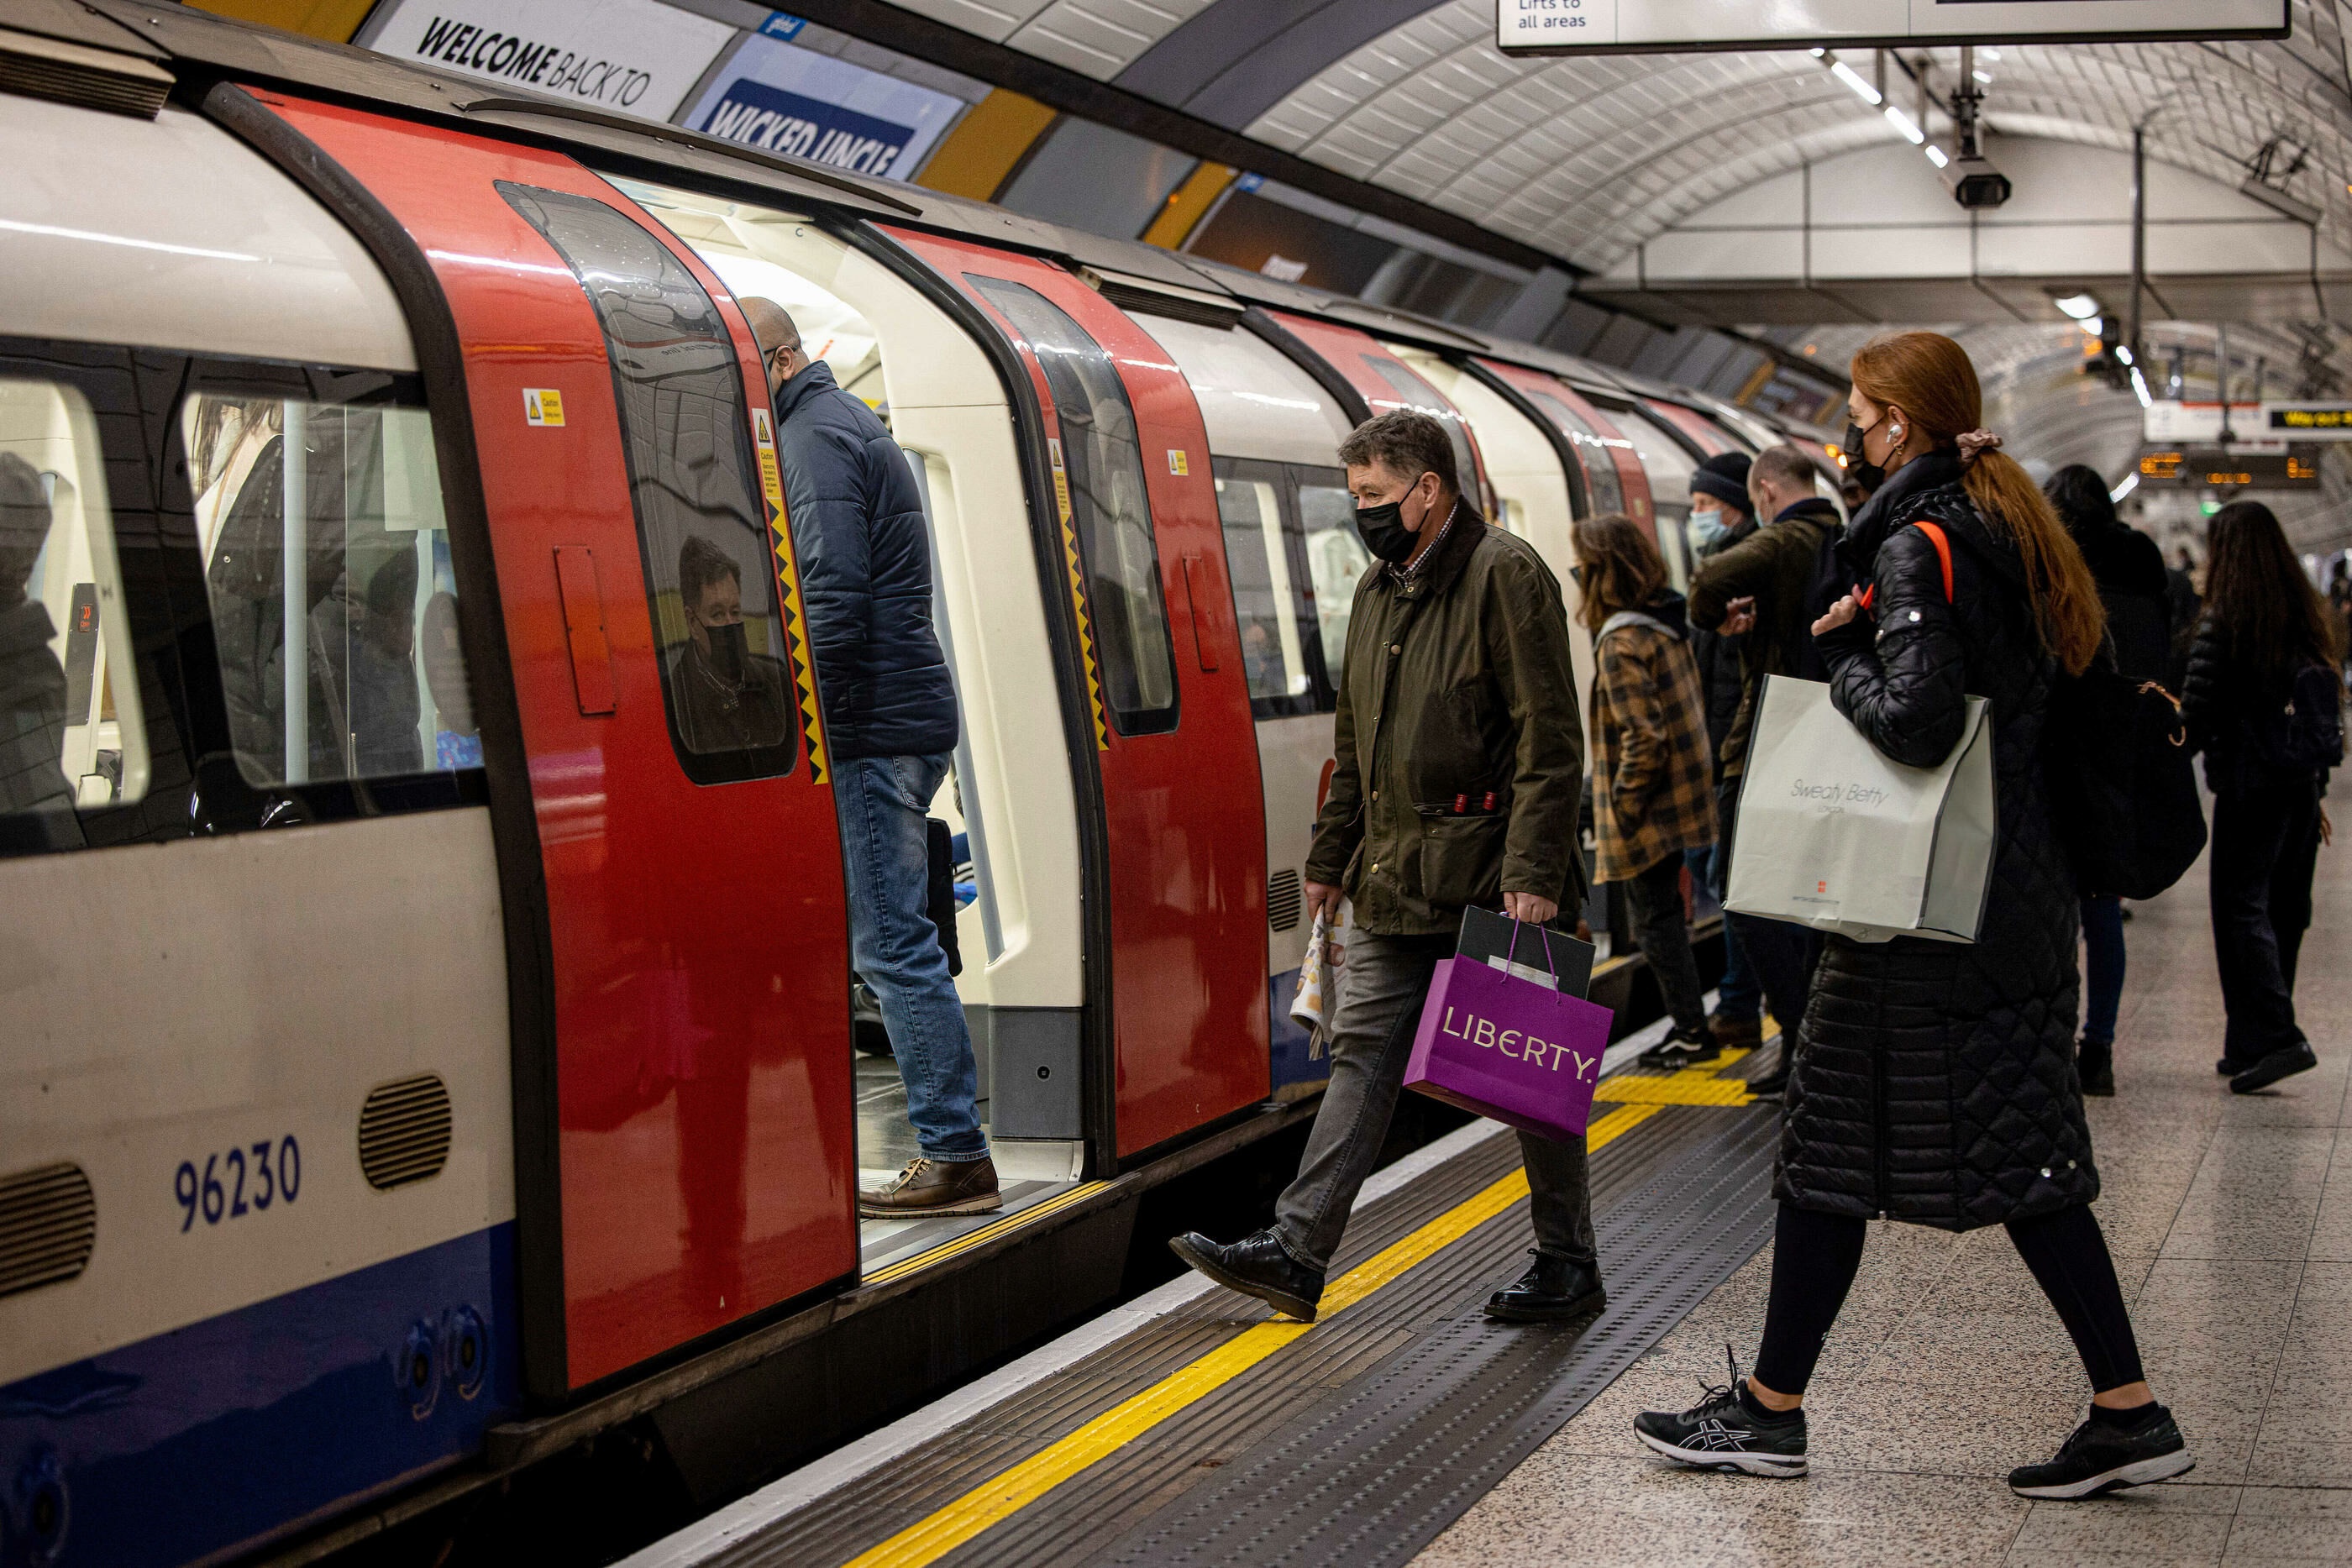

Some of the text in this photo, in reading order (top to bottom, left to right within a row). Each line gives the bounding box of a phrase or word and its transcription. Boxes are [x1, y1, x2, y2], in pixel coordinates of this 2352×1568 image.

[1519, 15, 1586, 29] all areas
[1520, 0, 1581, 9] Lifts to
[417, 16, 651, 107] WELCOME BACK TO
[707, 99, 818, 159] WICKED
[1791, 779, 1890, 808] Sweaty Betty
[175, 1135, 301, 1234] 96230
